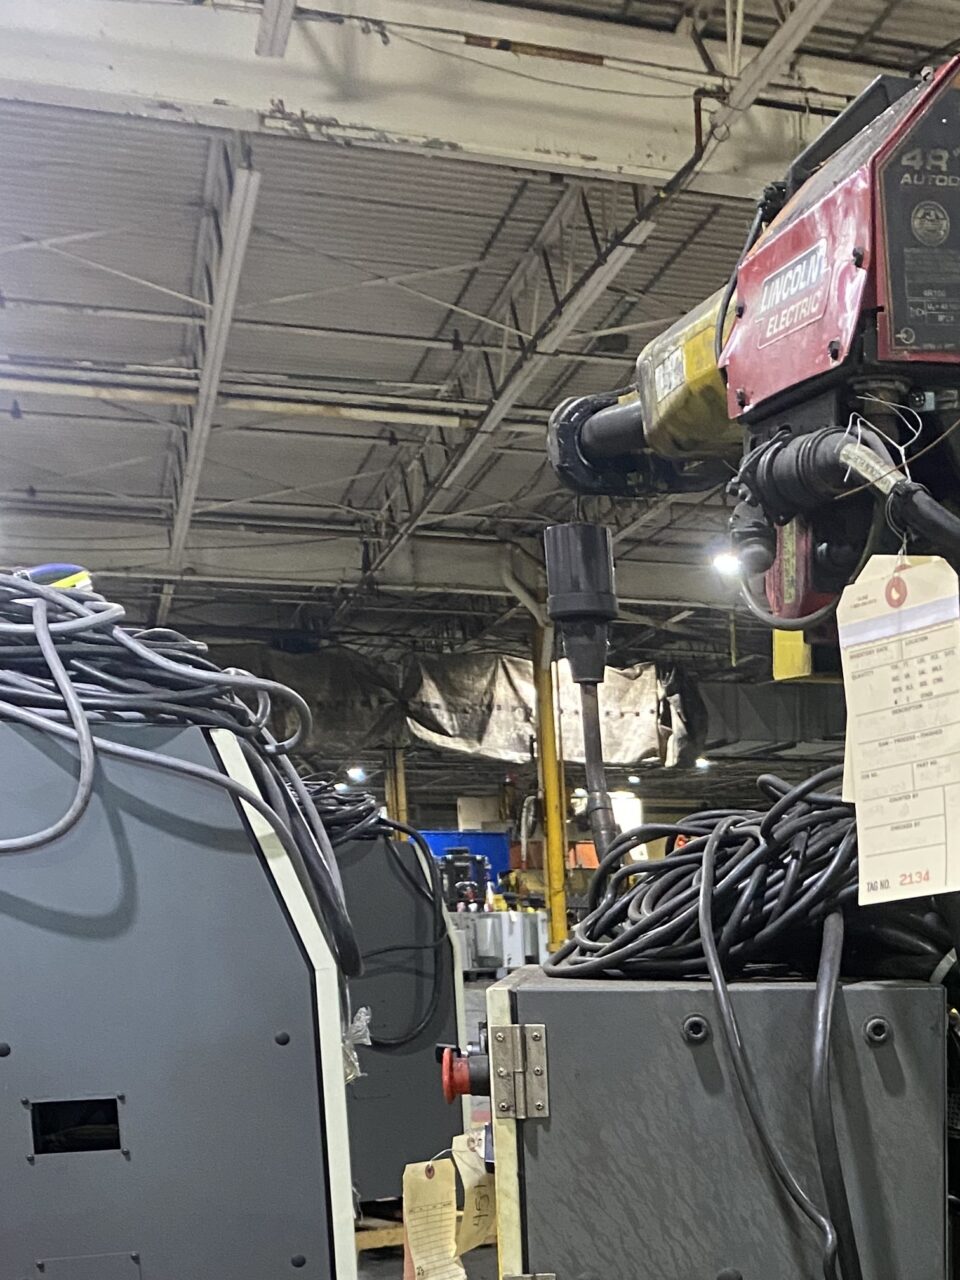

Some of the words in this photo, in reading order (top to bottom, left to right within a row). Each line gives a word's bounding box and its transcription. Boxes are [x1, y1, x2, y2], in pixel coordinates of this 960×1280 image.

[760, 250, 823, 313] LINCOLN
[766, 290, 821, 338] ELECTRIC
[867, 881, 878, 893] TAG
[880, 879, 891, 890] NO.
[899, 869, 930, 886] 2134
